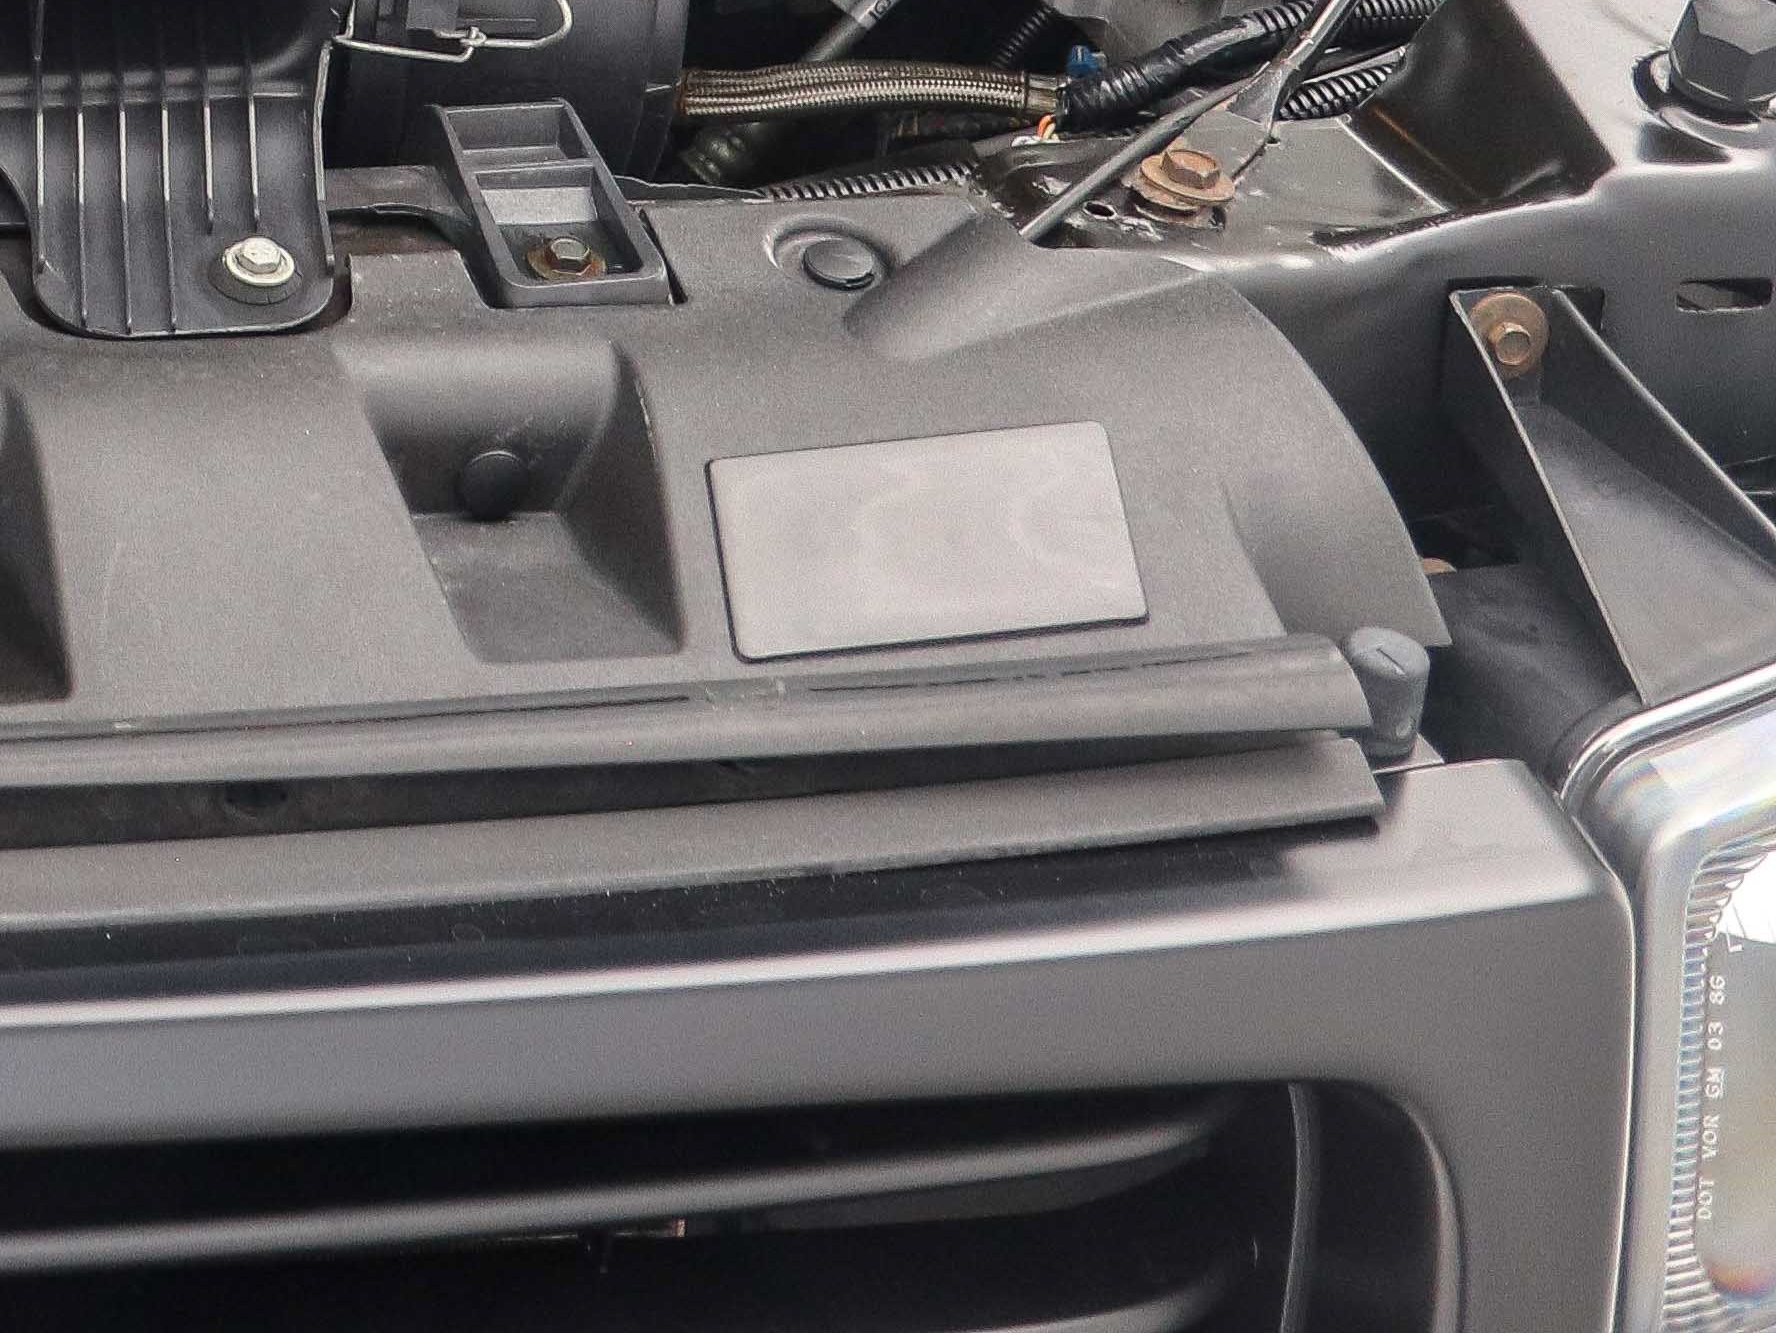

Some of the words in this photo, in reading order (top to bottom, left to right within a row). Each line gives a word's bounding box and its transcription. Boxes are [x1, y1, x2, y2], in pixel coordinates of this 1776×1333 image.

[1707, 1021, 1724, 1051] 03
[1705, 1068, 1725, 1099] GM
[1702, 1114, 1720, 1160] VOR
[1697, 1177, 1715, 1220] DOT
